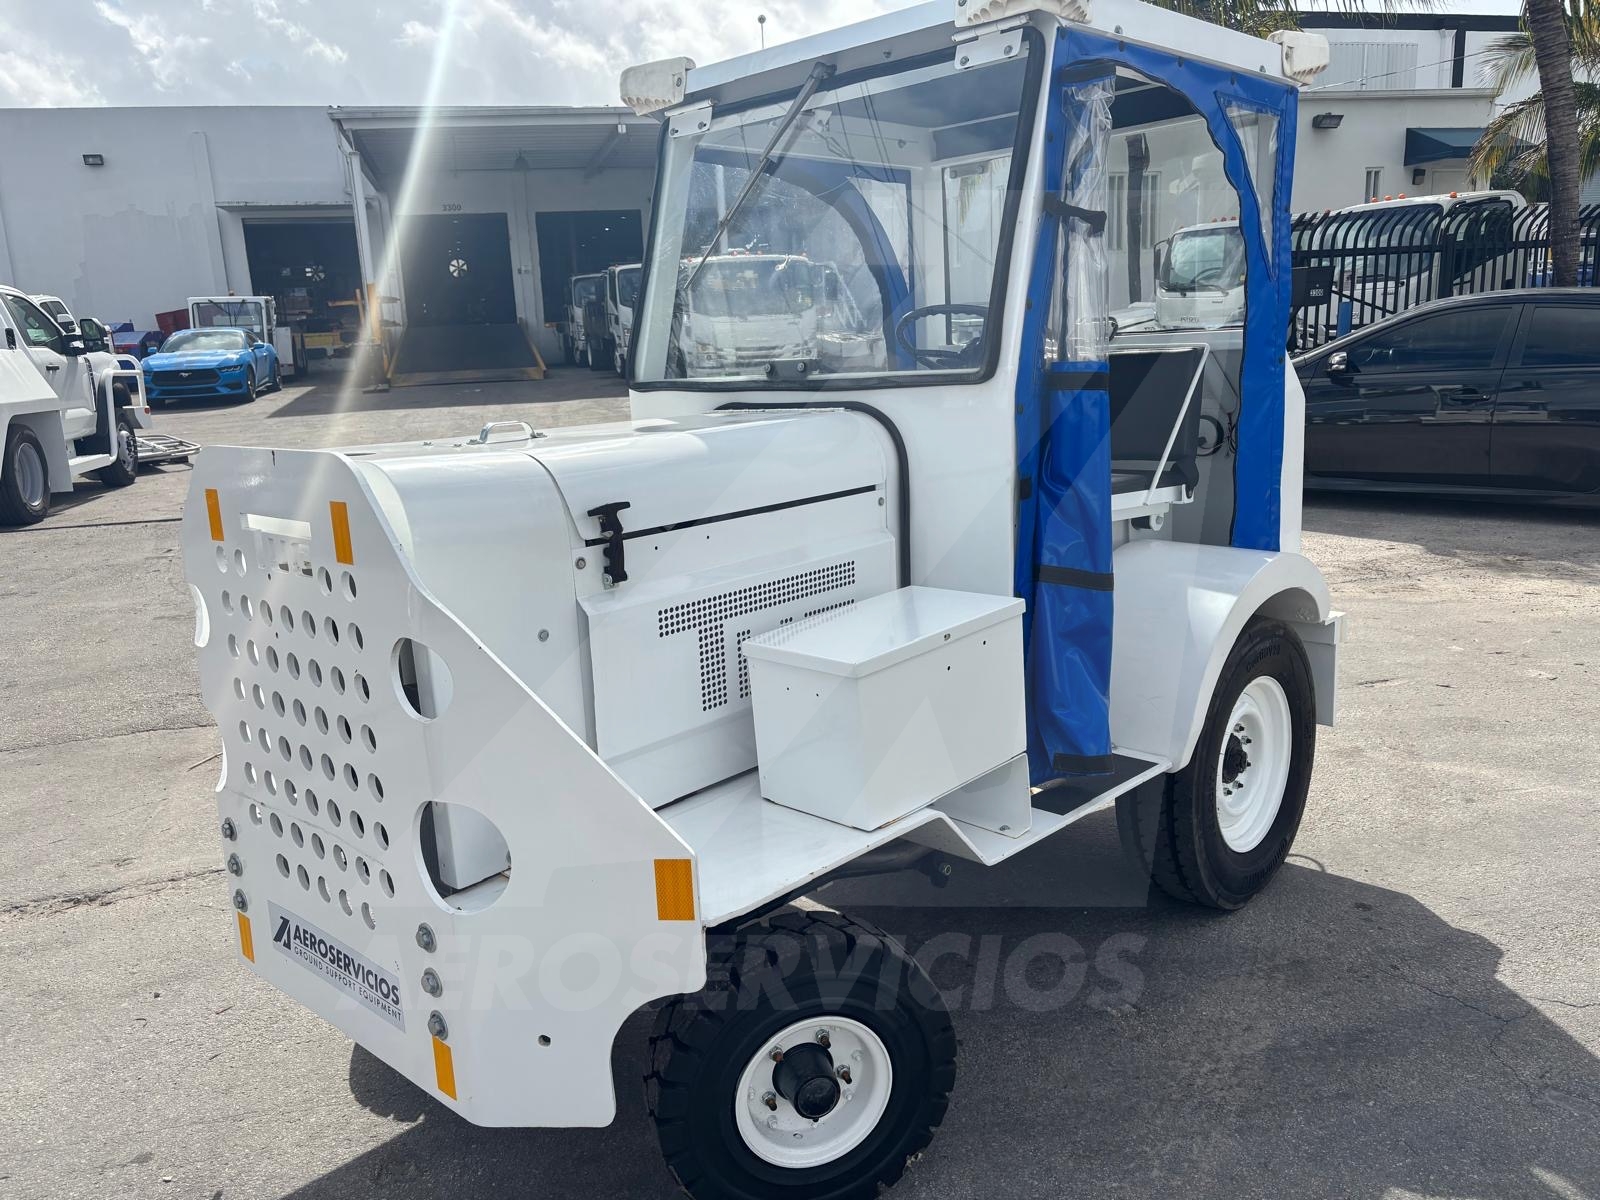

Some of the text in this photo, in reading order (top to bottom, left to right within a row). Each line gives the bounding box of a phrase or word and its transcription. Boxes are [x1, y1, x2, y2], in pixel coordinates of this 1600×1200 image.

[293, 924, 400, 1006] AEROSERVICIOS
[294, 945, 401, 1021] GROUND SUPPORT EQUIPMENT
